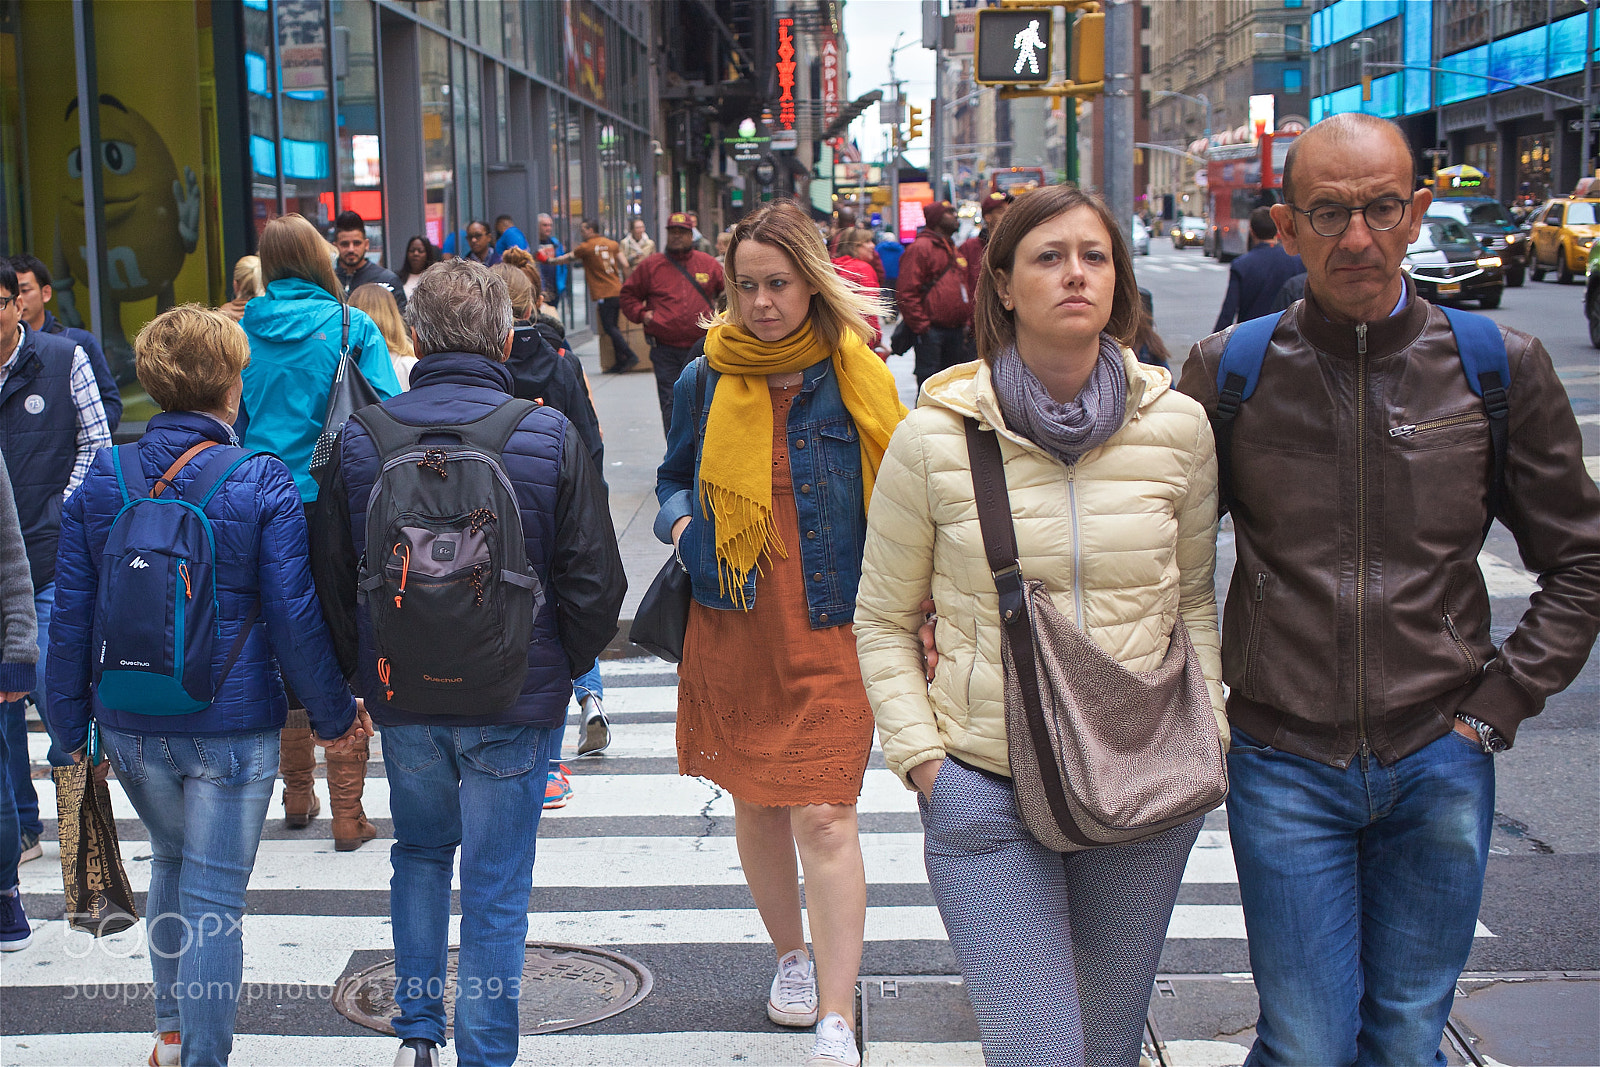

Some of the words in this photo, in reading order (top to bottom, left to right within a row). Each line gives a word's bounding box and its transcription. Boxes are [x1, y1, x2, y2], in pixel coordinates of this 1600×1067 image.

[119, 659, 150, 667] Quechua
[423, 674, 463, 683] Quechua
[91, 903, 100, 919] Hard
